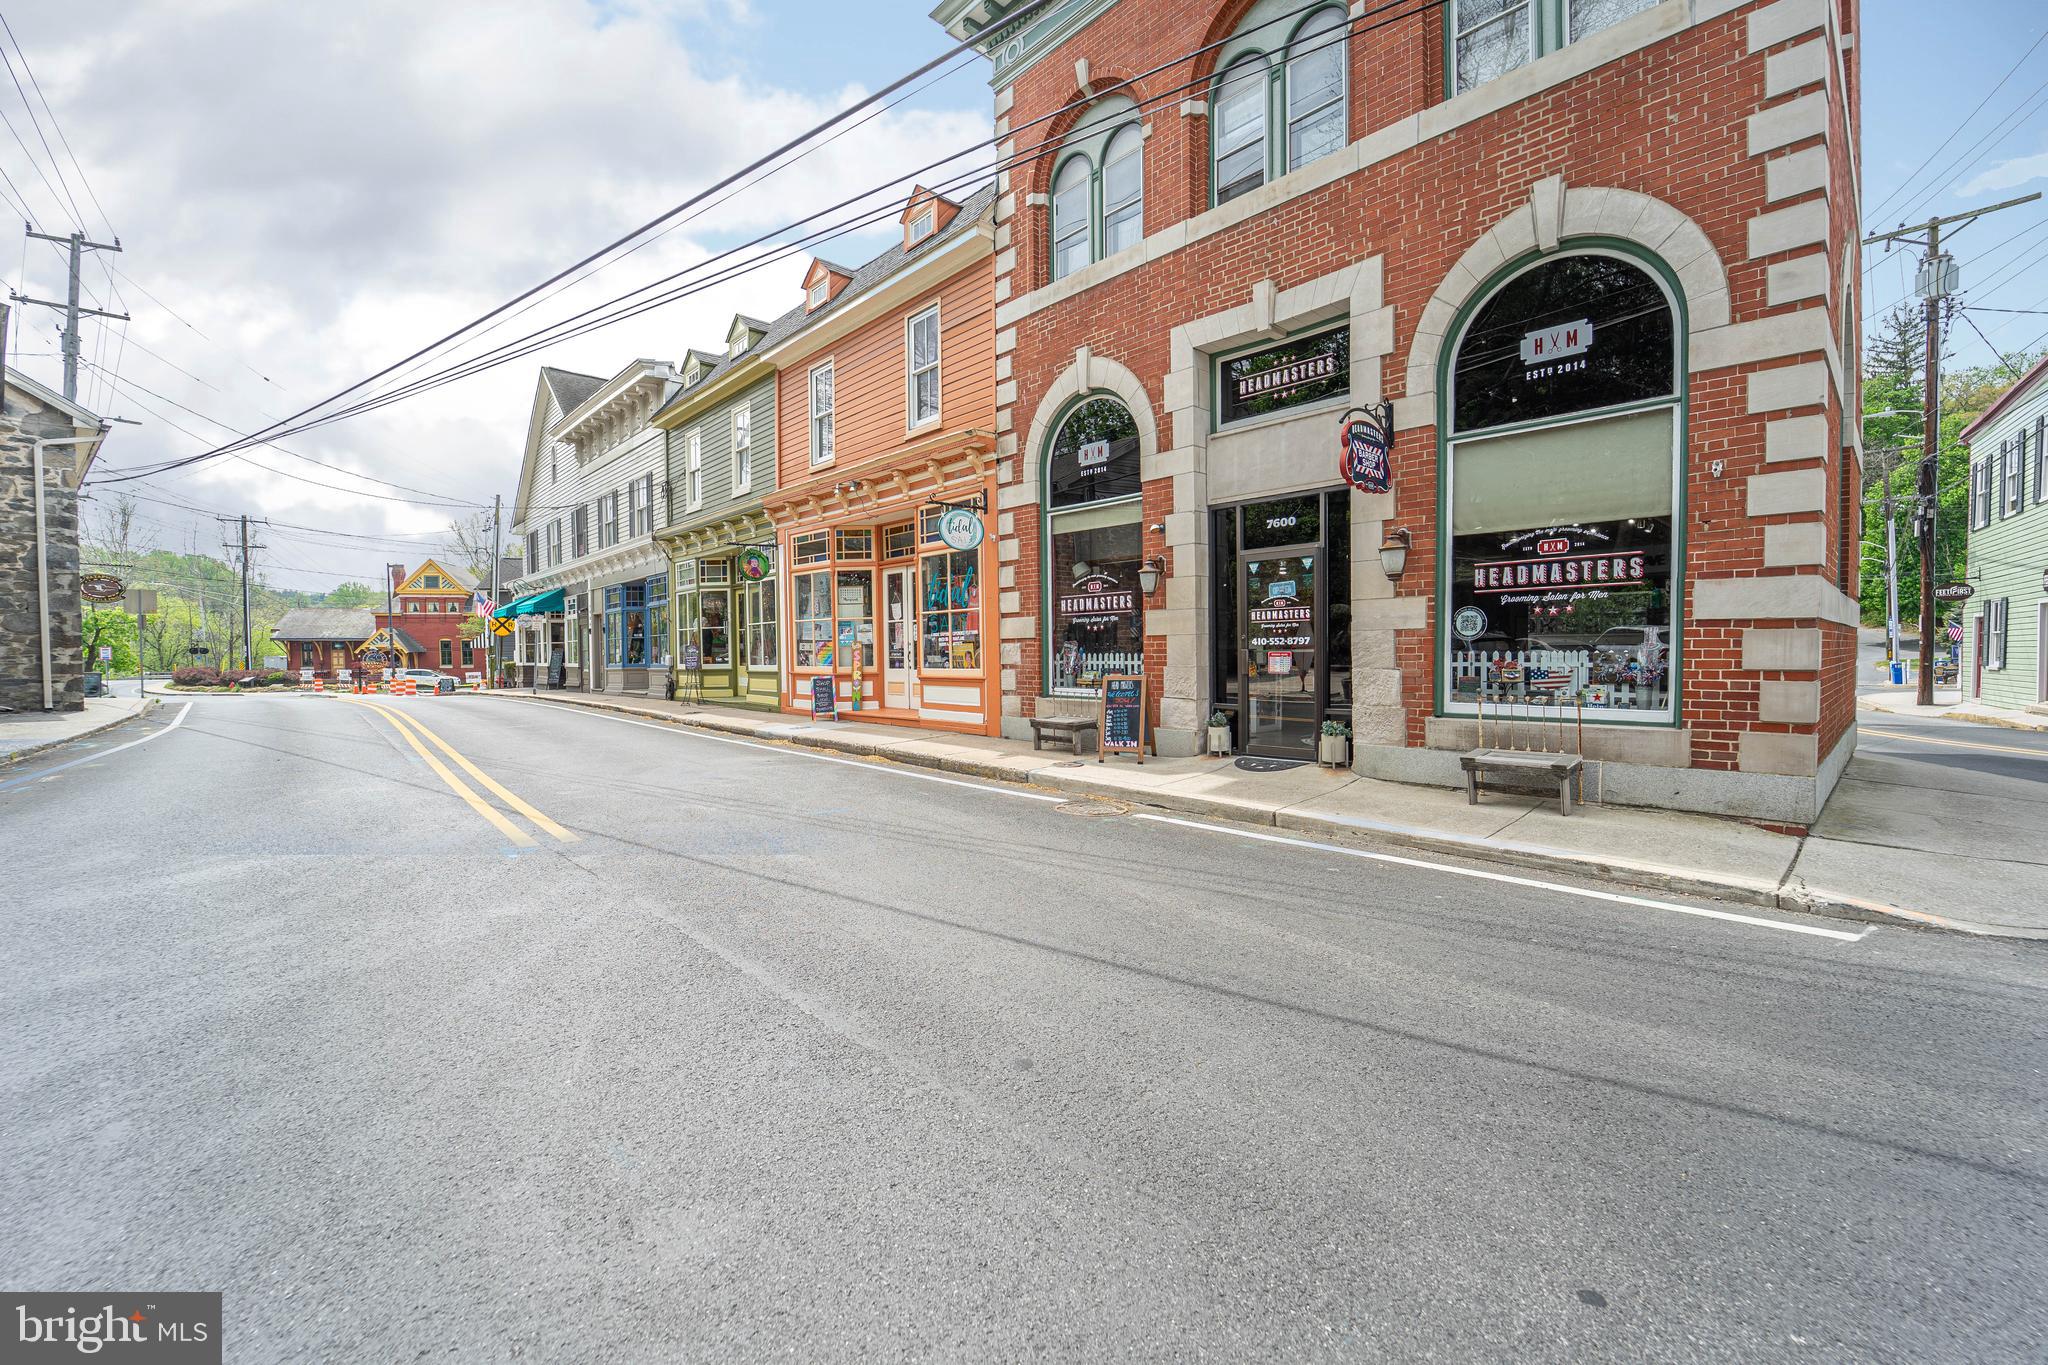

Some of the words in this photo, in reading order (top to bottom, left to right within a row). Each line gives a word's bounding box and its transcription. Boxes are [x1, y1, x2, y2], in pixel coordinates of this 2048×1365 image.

[1557, 360, 1585, 374] 2014
[1240, 357, 1335, 395] HEADMASTERS
[1352, 424, 1384, 443] HEADMASTERS
[1358, 449, 1379, 463] BARBER
[1362, 458, 1376, 468] SHOP
[947, 516, 974, 535] tidal
[1266, 516, 1297, 529] 7600
[1474, 557, 1644, 588] HEADMASTERS
[928, 566, 974, 608] tidal
[1936, 587, 1951, 597] FEET
[1951, 585, 1972, 597] FIRST
[1061, 595, 1132, 612] HEADMASTERS
[1501, 594, 1539, 606] Grooming
[1541, 592, 1568, 602] Salon
[1570, 592, 1586, 603] for
[1588, 591, 1608, 599] Men
[1251, 609, 1311, 620] HEADMASTERS
[929, 613, 968, 633] SALT
[1252, 636, 1311, 645] 410-552-8797
[1126, 740, 1138, 748] IN
